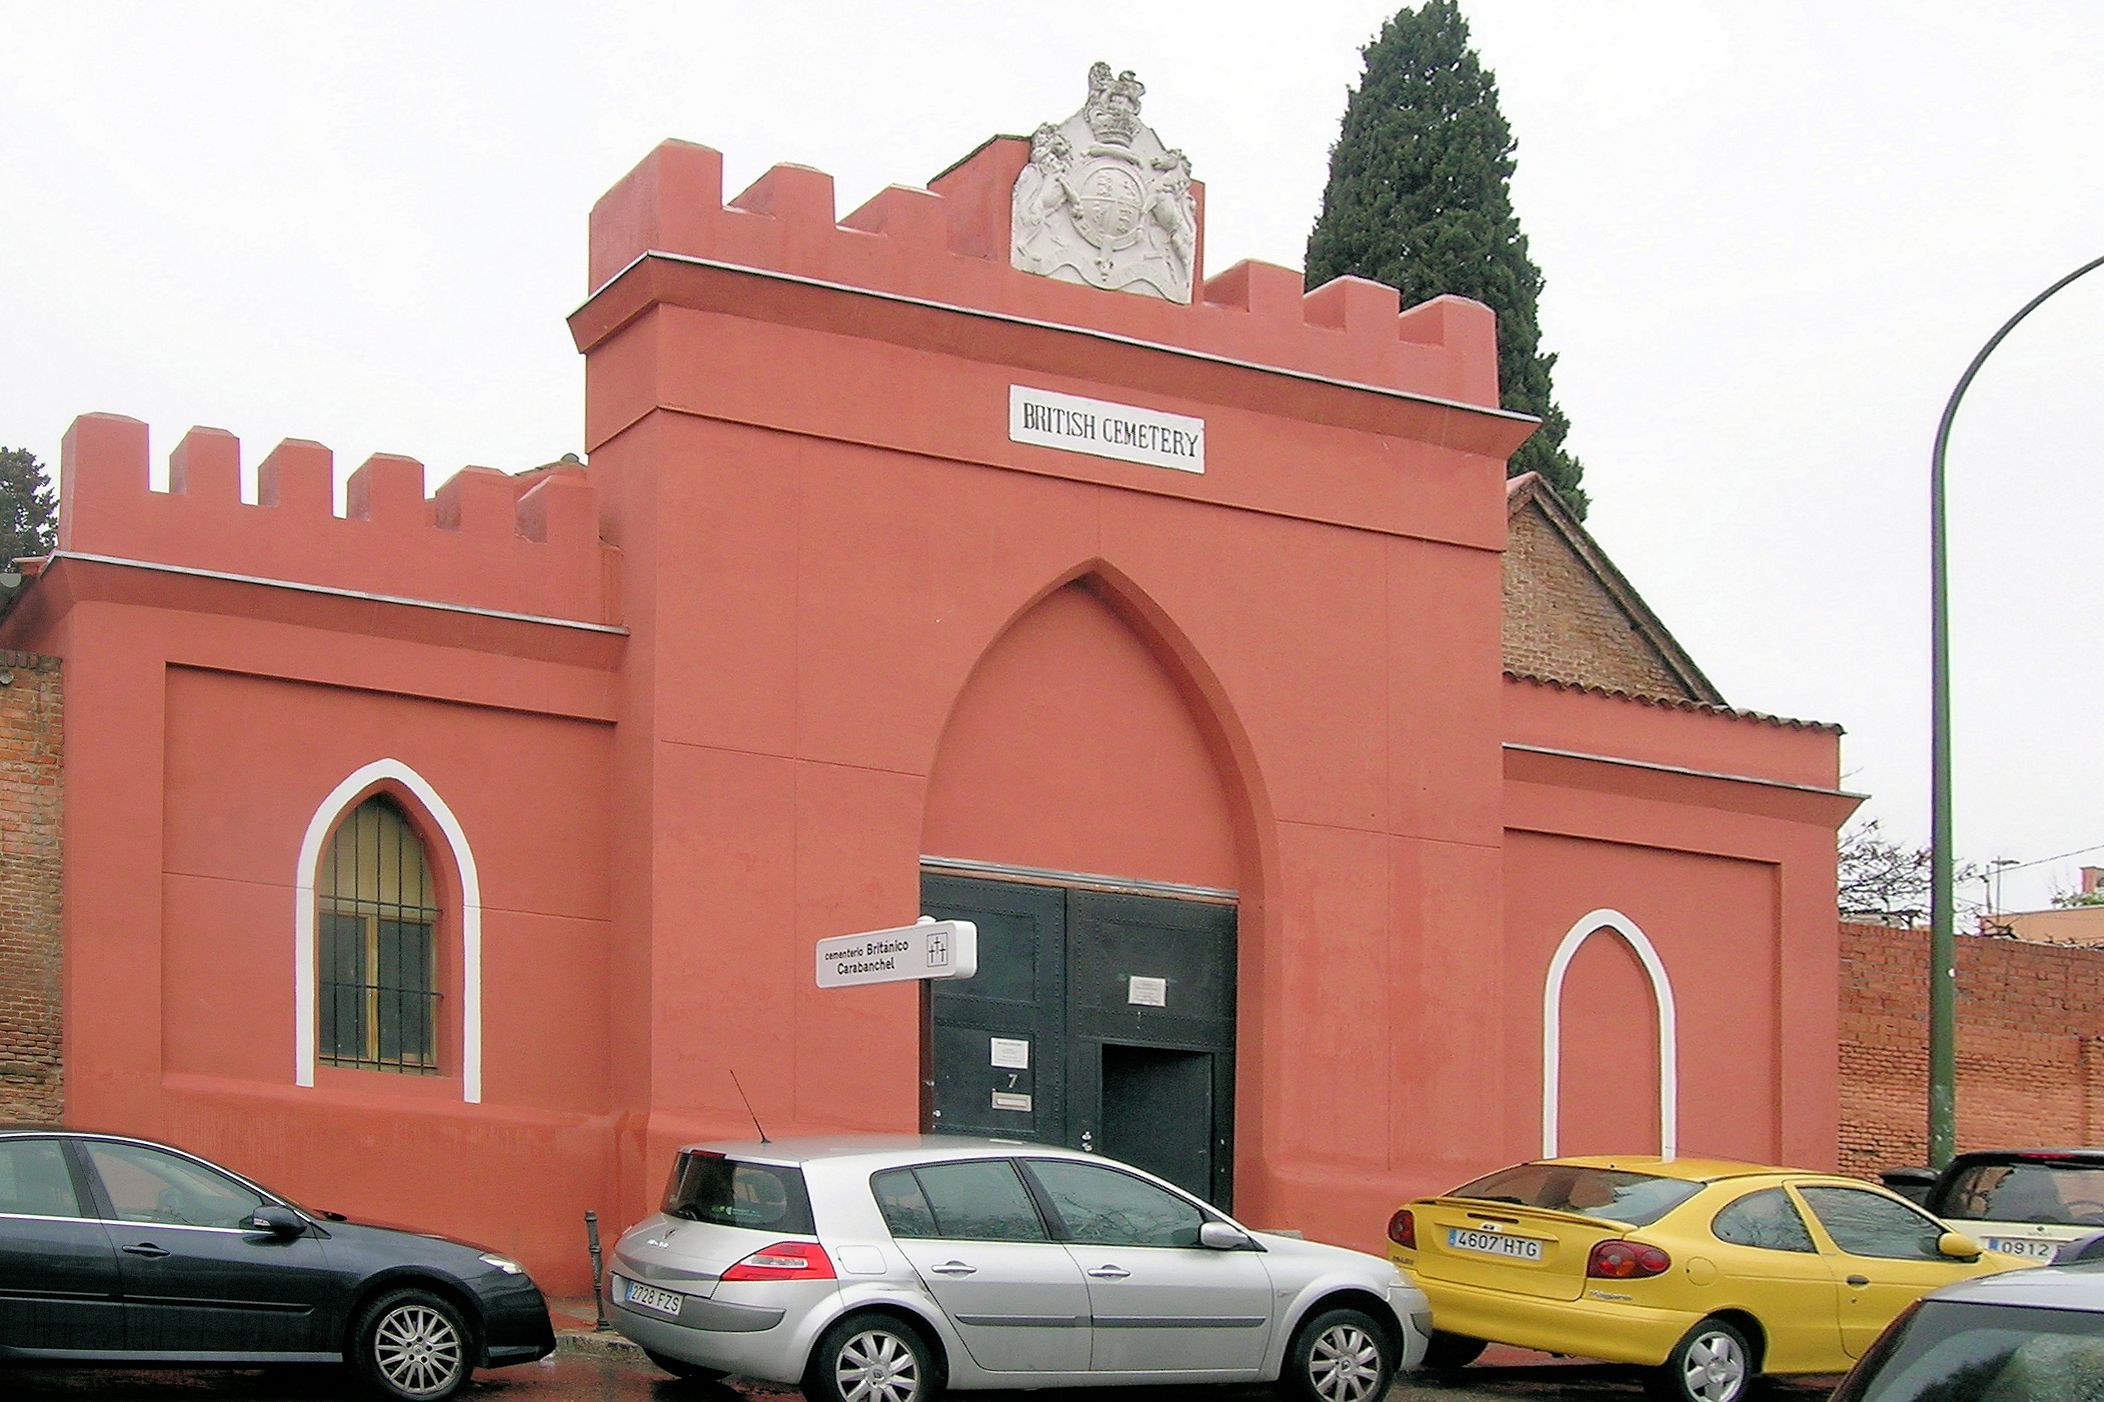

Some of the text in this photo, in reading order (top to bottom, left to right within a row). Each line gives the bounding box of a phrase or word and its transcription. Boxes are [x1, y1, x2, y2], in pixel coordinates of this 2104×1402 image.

[1023, 402, 1199, 457] BRITISH CEMETERY
[825, 939, 909, 961] cementerio Británico
[837, 957, 895, 975] Carabanchel
[1008, 1073, 1018, 1088] 7
[1458, 1232, 1537, 1257] 4607 HTG
[2002, 1241, 2049, 1256] 0912
[631, 1285, 680, 1312] 2728 FZS
